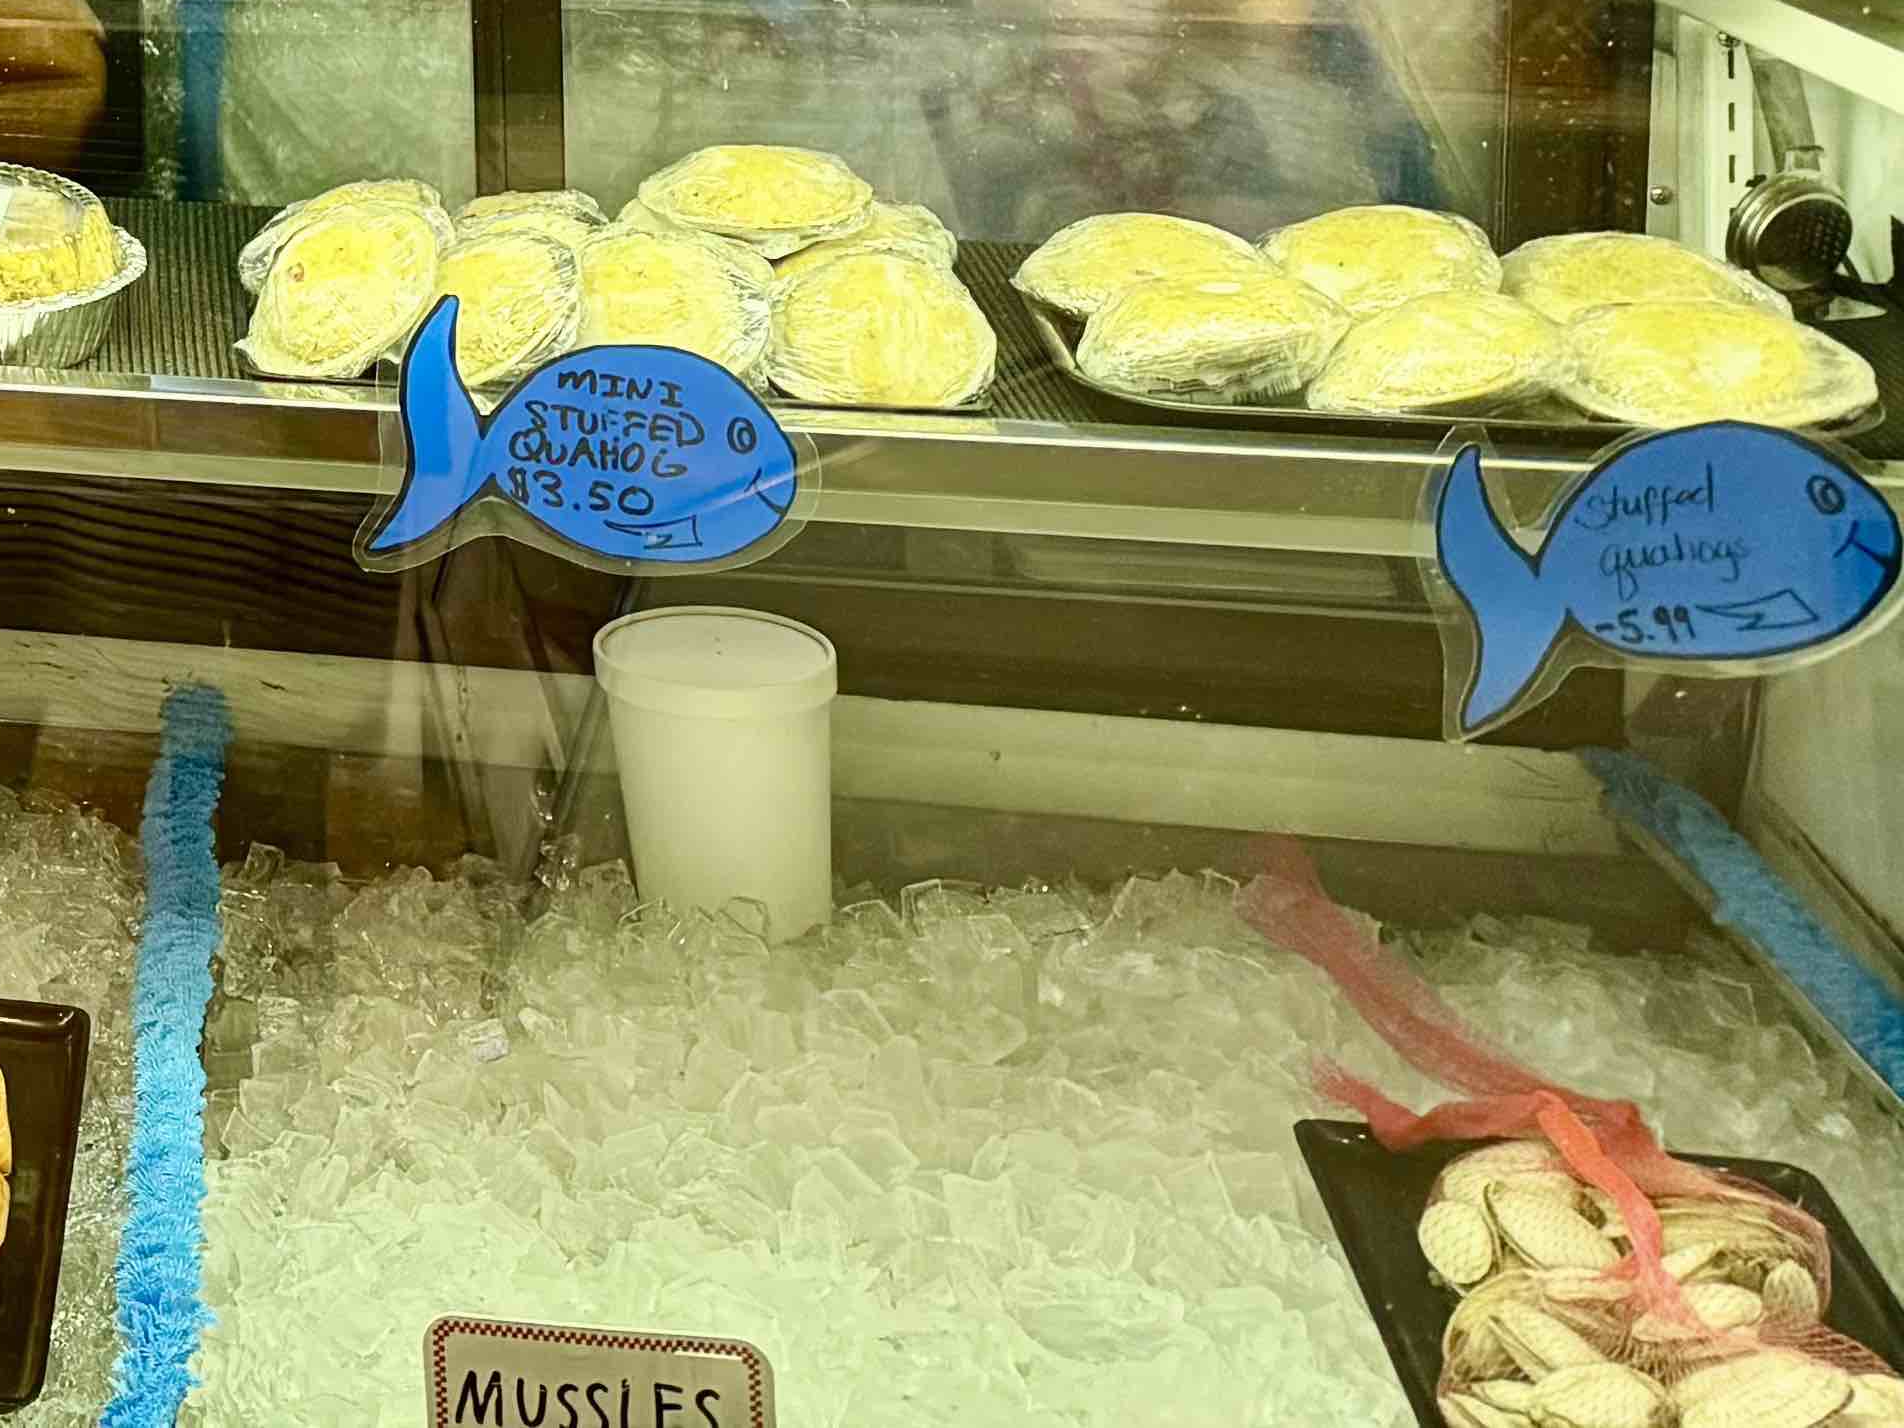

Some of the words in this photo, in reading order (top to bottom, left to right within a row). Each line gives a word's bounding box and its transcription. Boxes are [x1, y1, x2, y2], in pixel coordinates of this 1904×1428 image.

[558, 369, 683, 408] MINI
[526, 400, 705, 446] STUFFED
[508, 424, 688, 478] QUAHOG
[510, 466, 655, 517] $3.50
